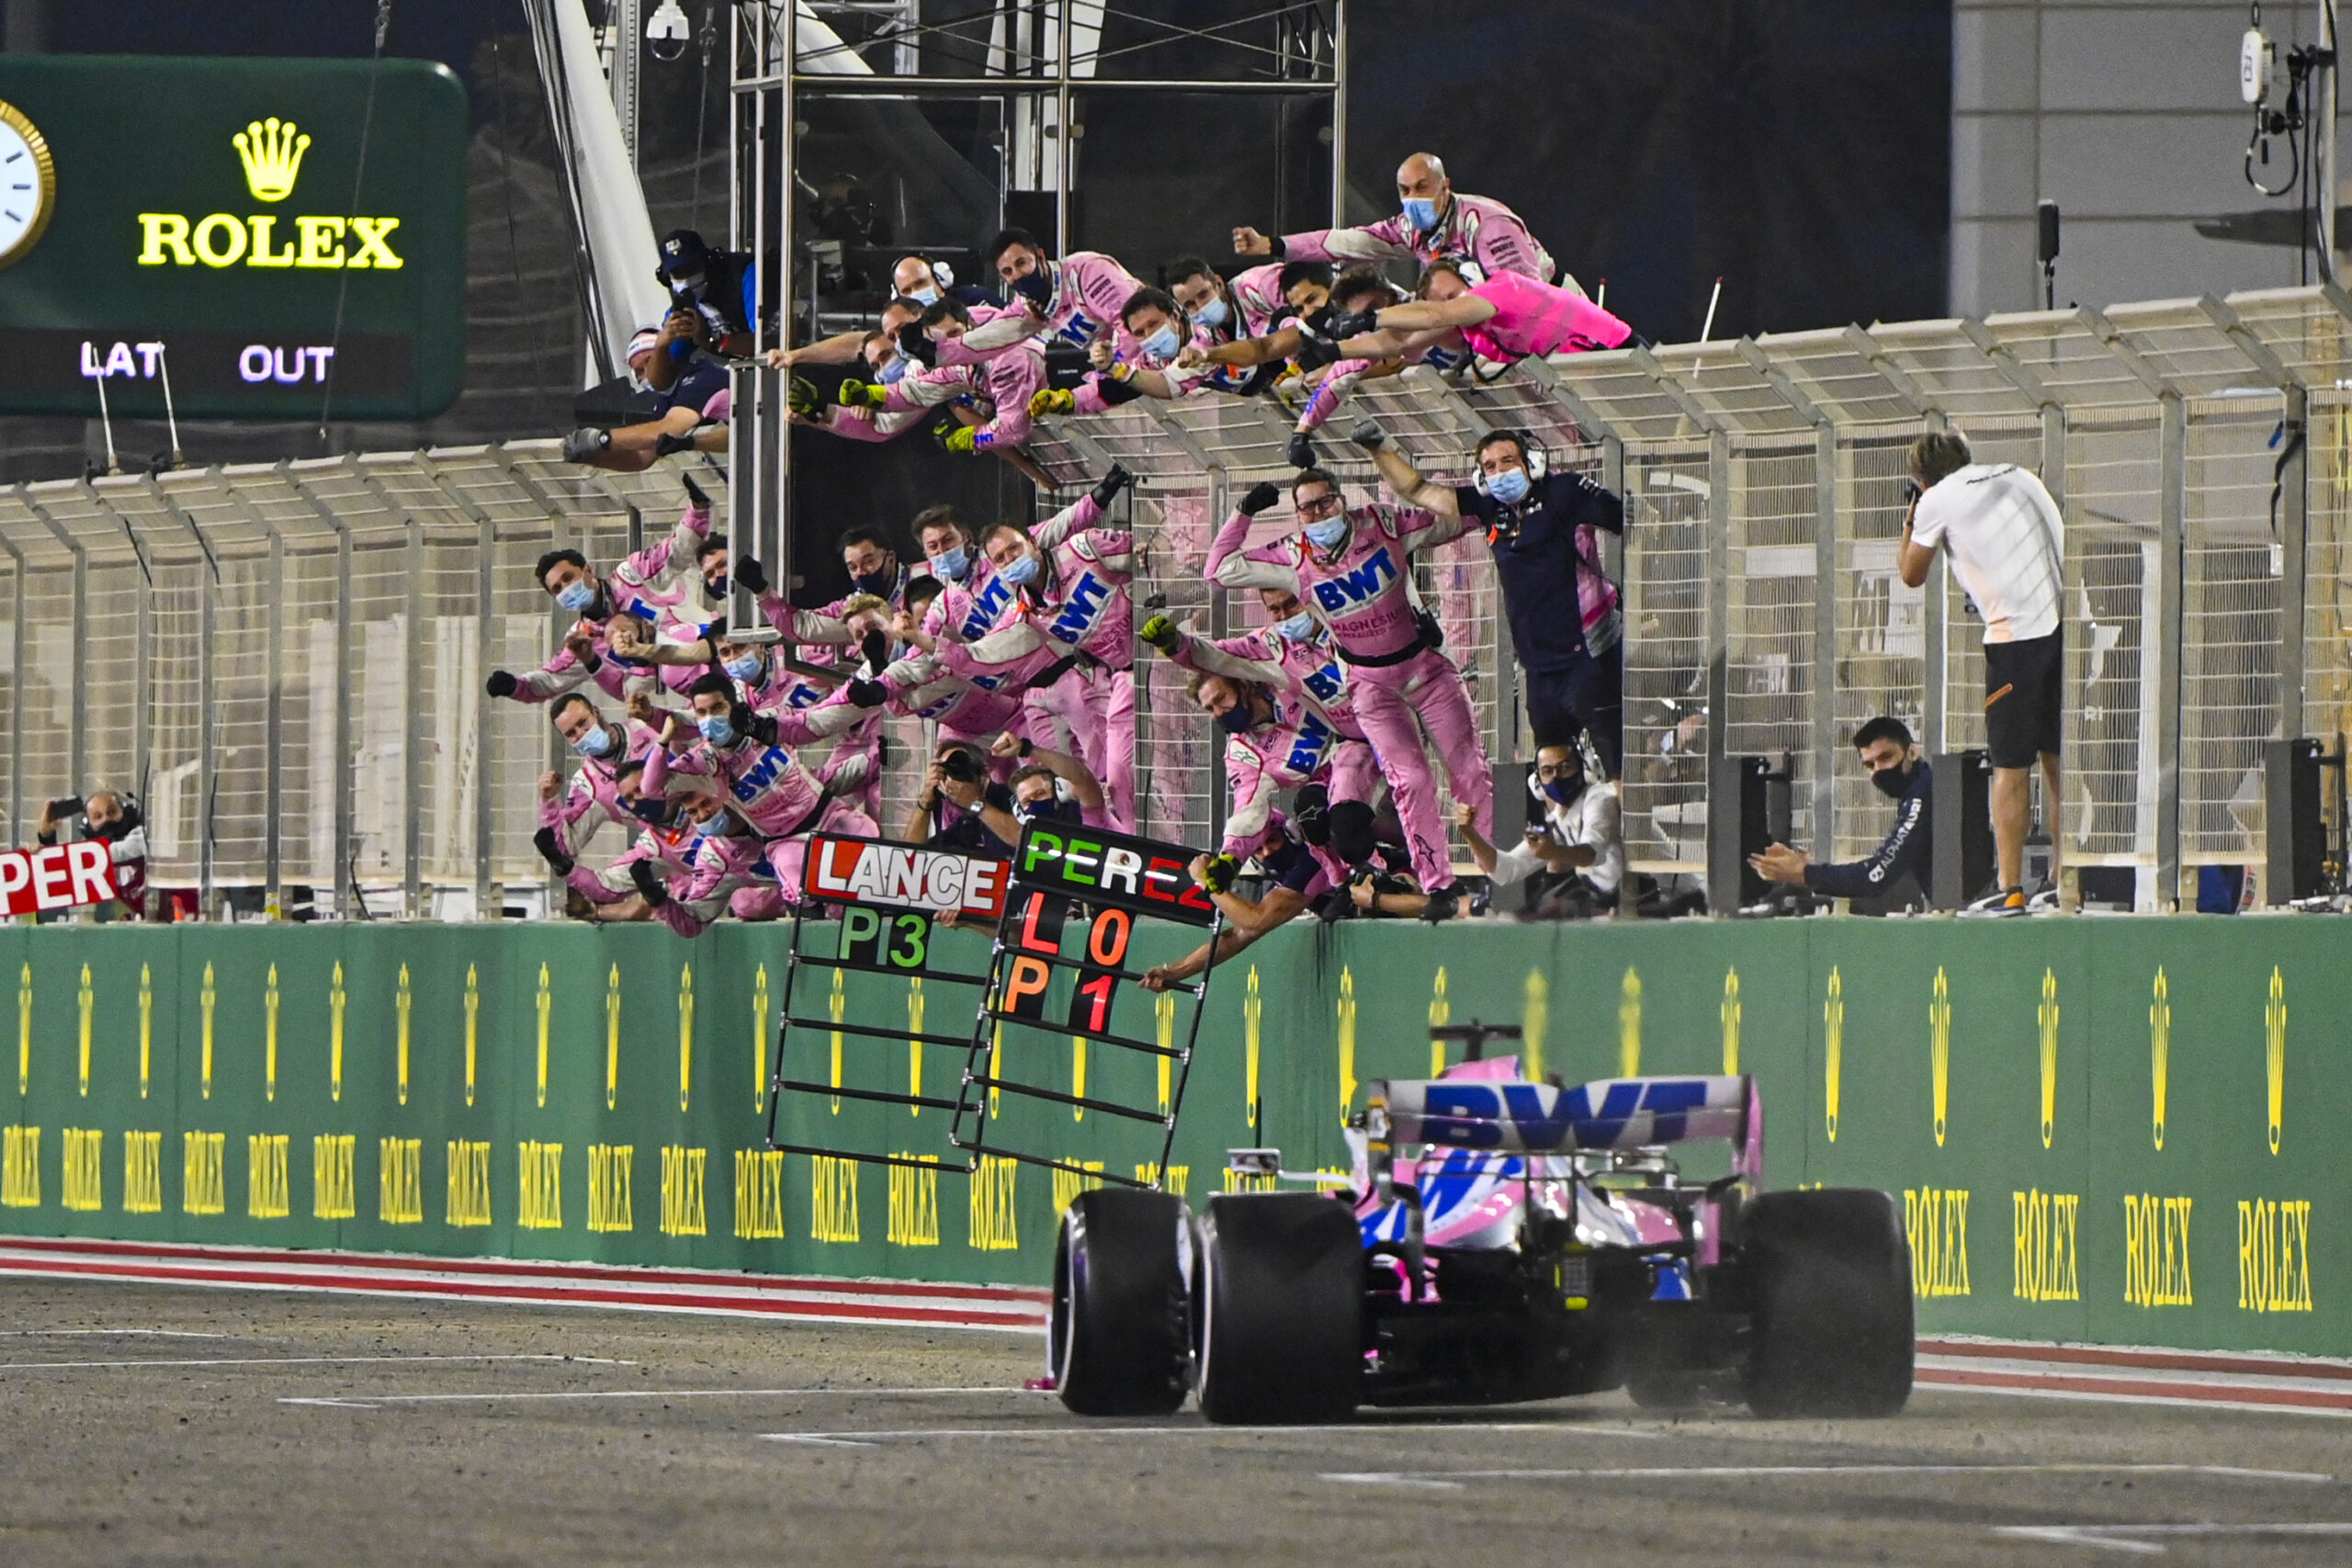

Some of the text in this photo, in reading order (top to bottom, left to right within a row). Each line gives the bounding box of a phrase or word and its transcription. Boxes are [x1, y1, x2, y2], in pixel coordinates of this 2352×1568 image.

[138, 213, 403, 268] ROLEX
[80, 341, 334, 383] LAT OUT
[961, 575, 1011, 642] BWT
[1049, 571, 1109, 645] BWT
[1313, 546, 1397, 613] BWT
[734, 745, 789, 803] BWT
[1286, 710, 1330, 775] BW
[0, 840, 115, 915] PER
[817, 840, 999, 910] LANCE
[1021, 891, 1059, 955] L
[1003, 954, 1113, 1032] P 1
[1419, 1080, 1708, 1150] BWT
[1905, 1187, 1971, 1299] ROLEX
[2013, 1190, 2080, 1303] ROLEX
[2125, 1193, 2194, 1306] ROLEX
[2238, 1198, 2312, 1313] ROLEX
